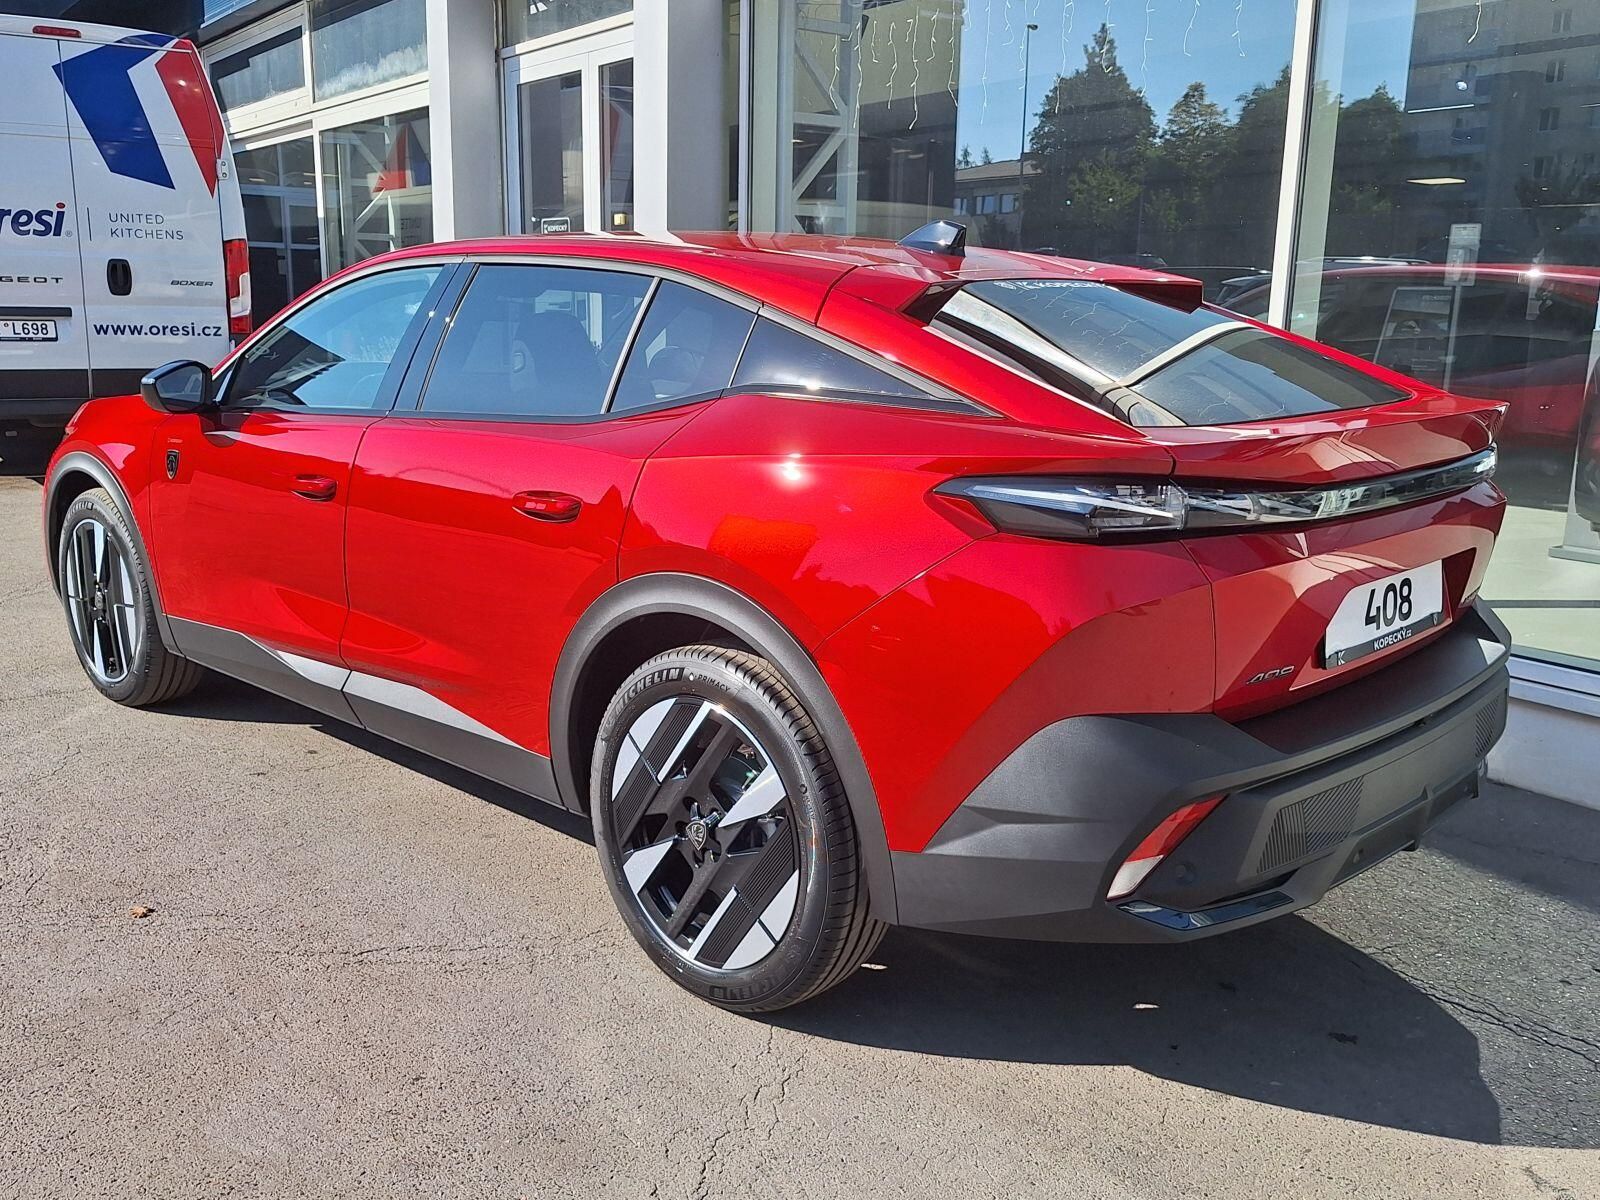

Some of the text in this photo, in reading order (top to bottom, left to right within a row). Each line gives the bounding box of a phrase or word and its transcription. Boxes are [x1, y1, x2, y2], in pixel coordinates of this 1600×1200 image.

[109, 213, 164, 224] UNITED
[110, 228, 184, 240] KITCHENS
[93, 322, 223, 337] www.oresi.cz
[1364, 577, 1413, 631] 408
[614, 668, 681, 715] MICHELIN
[698, 674, 731, 693] PRIMACY
